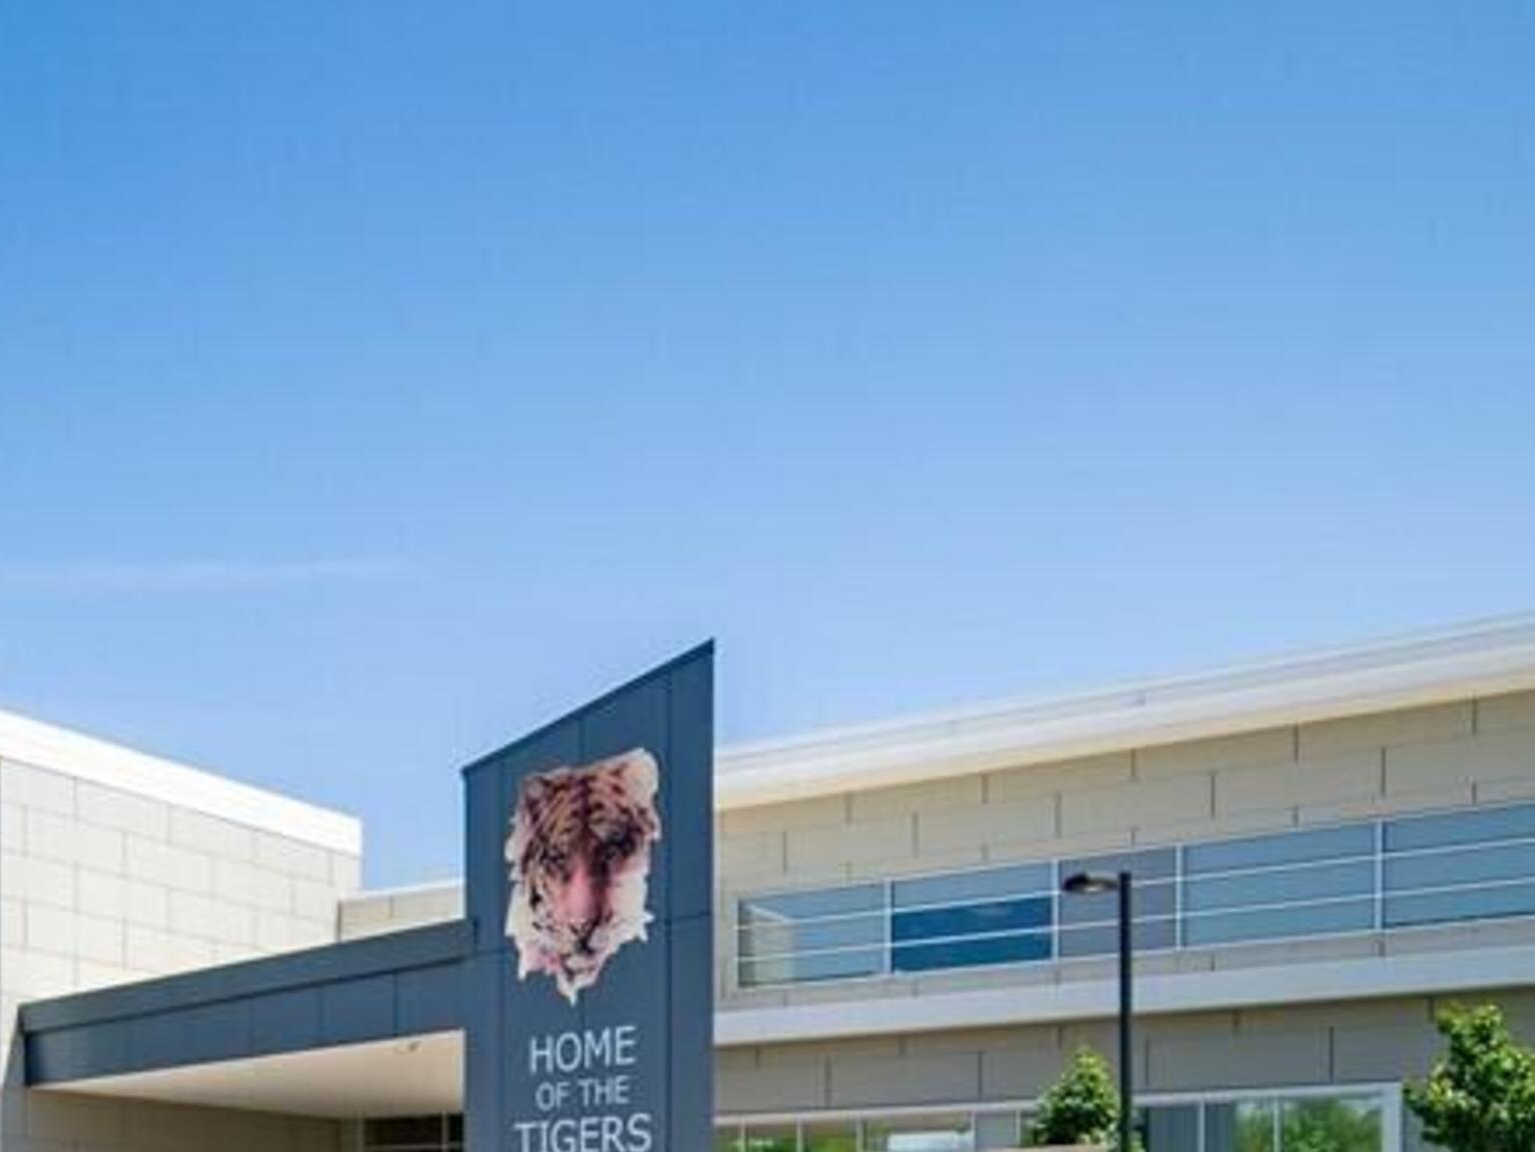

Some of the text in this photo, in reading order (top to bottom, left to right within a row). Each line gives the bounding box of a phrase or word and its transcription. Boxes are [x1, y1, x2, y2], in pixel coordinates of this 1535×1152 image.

[530, 1025, 636, 1074] HOME
[536, 1075, 630, 1111] OF THE
